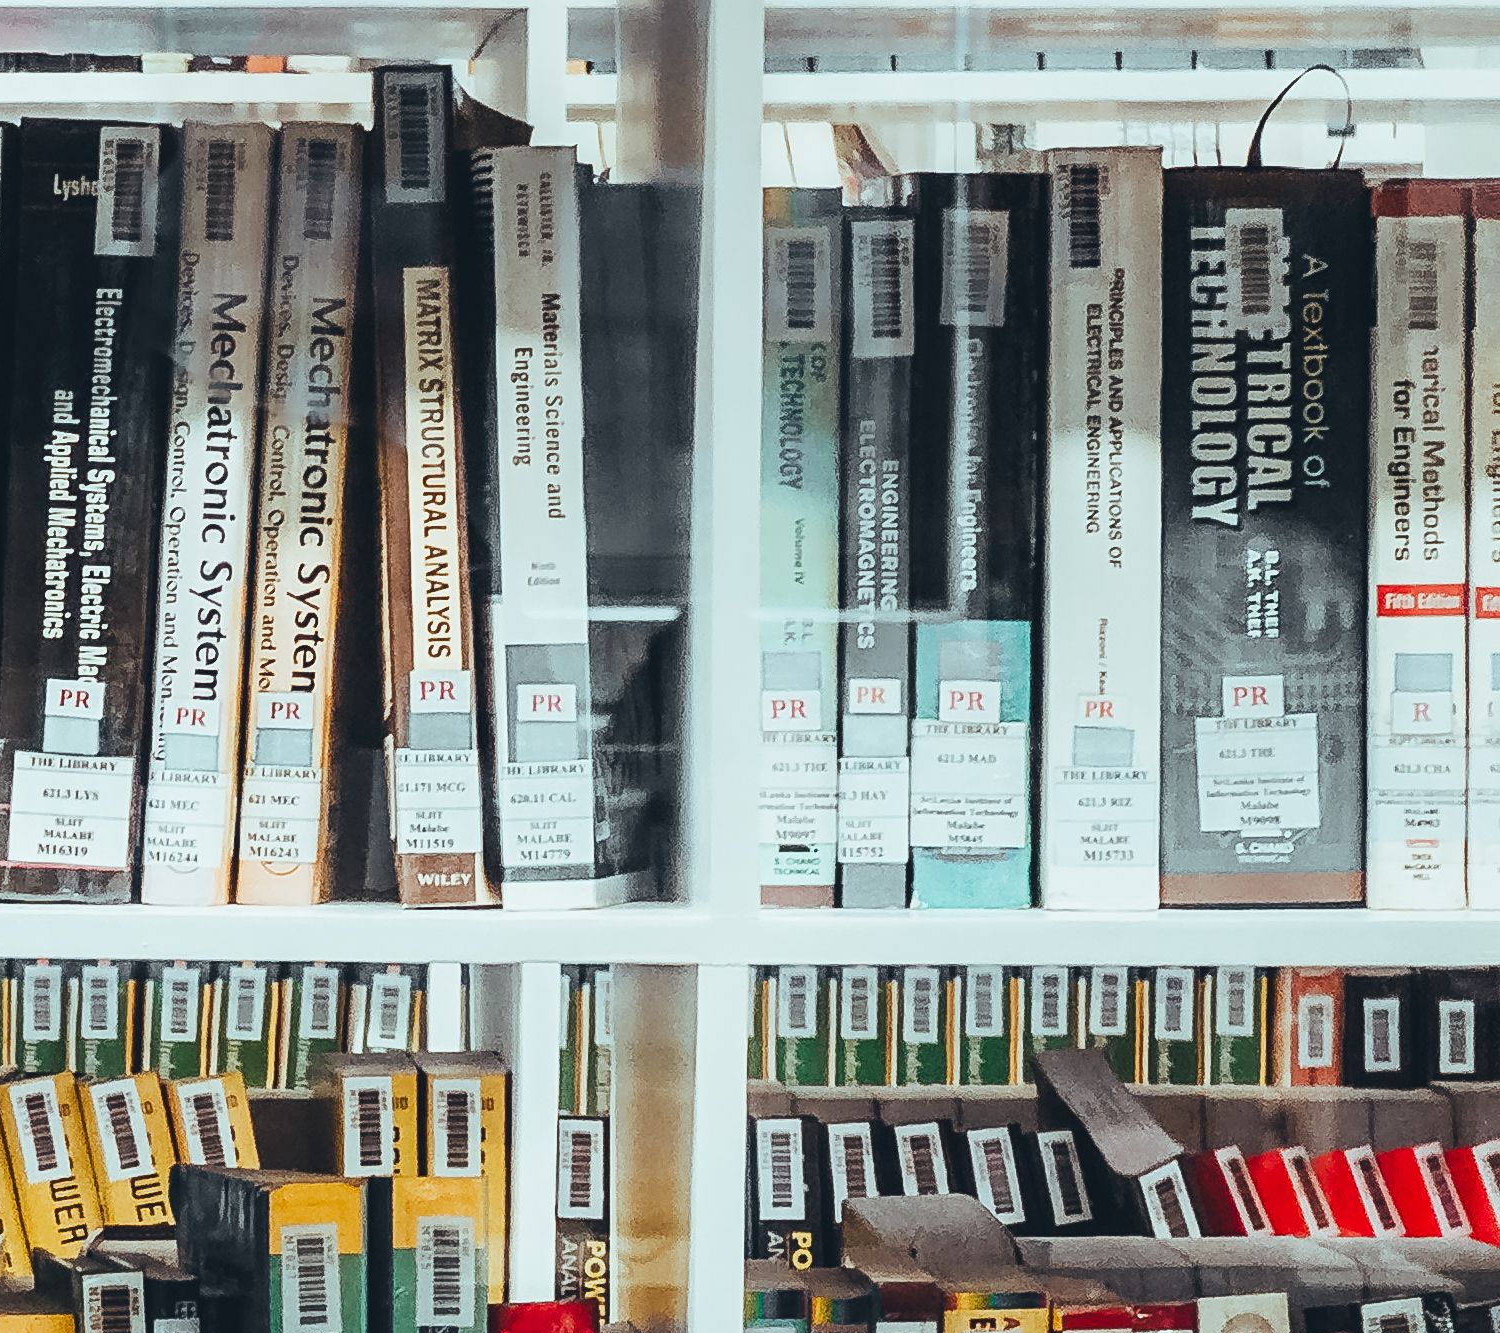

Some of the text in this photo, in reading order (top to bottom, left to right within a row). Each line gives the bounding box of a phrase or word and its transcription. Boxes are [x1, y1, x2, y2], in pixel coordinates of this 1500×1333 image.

[78, 288, 123, 644] Electromechanical Systems, Electric
[416, 278, 453, 660] MATRIX STRUCTURAL ANALYSIS
[511, 347, 532, 469] Engineering
[540, 293, 565, 521] Materials Science and
[1086, 303, 1103, 534] ELECTRICAL ENGINEERING
[1303, 255, 1329, 488] A Textbook of
[1388, 379, 1414, 563] for Engineers
[43, 389, 77, 639] and Applied Mechatronics
[192, 292, 247, 702] Mechatronic System
[856, 420, 878, 650] ELECTROMAGNETICS
[881, 459, 900, 614] ENGINEERING
[1422, 438, 1445, 562] Methods
[416, 872, 471, 888] WILEY
